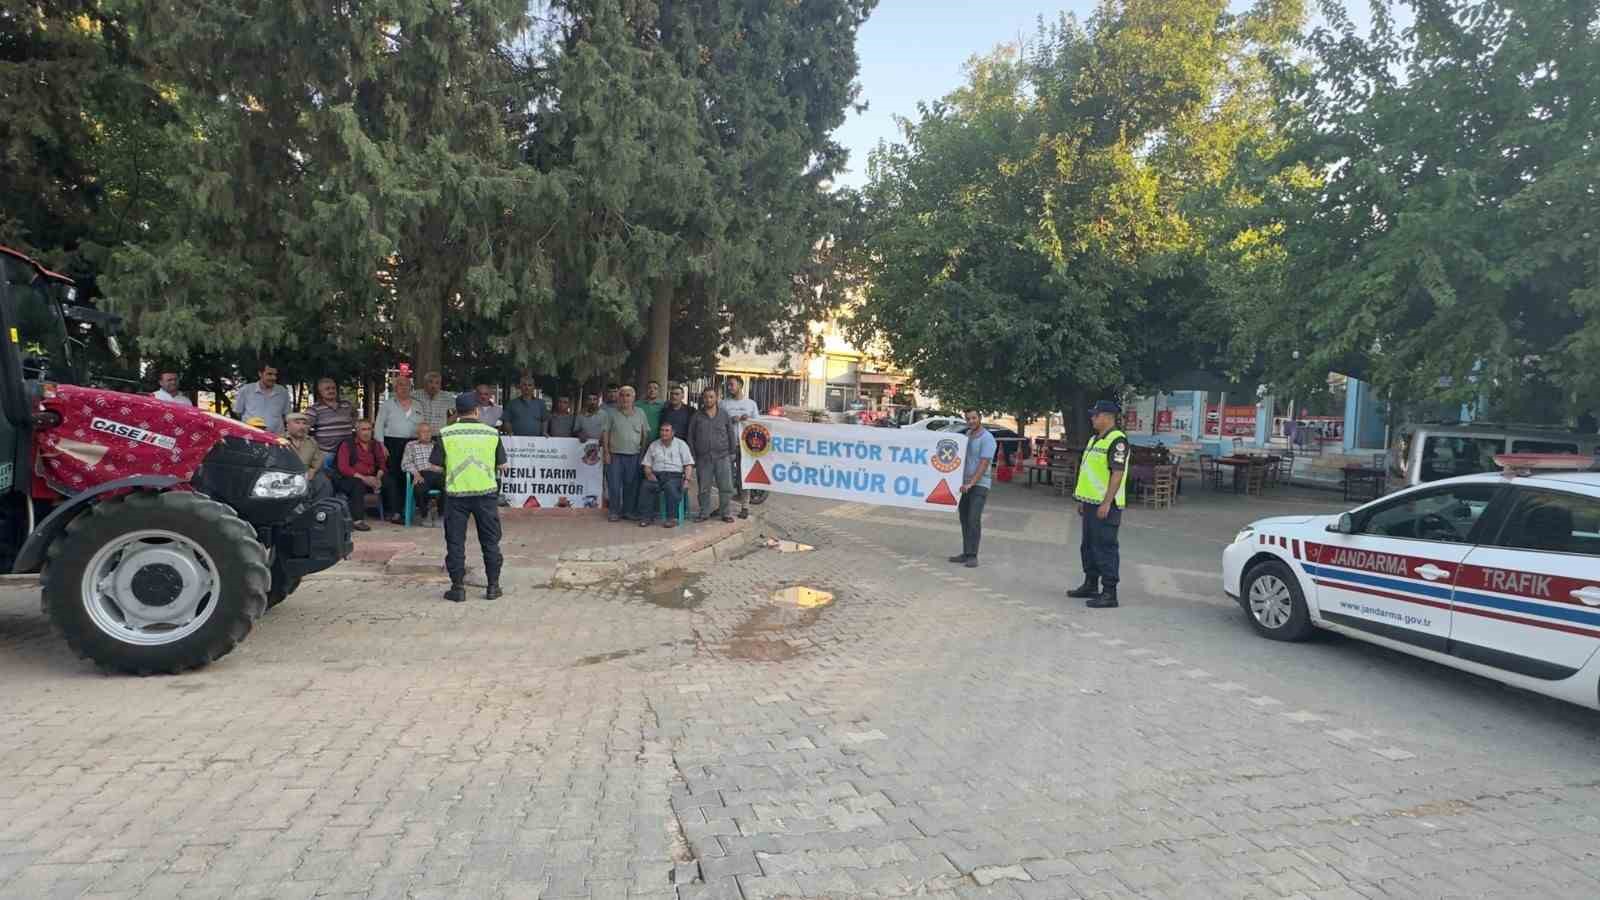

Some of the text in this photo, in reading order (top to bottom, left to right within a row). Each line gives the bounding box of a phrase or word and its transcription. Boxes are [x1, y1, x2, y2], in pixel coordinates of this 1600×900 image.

[93, 420, 140, 439] CASE
[771, 436, 882, 461] REFLEKTÖR
[888, 446, 928, 465] TAK
[540, 468, 577, 480] TARIM
[772, 461, 925, 497] GÖRÜNÜR OL
[1330, 548, 1408, 576] JANDARMA
[1340, 600, 1432, 626] www.jandarma.gov.tr
